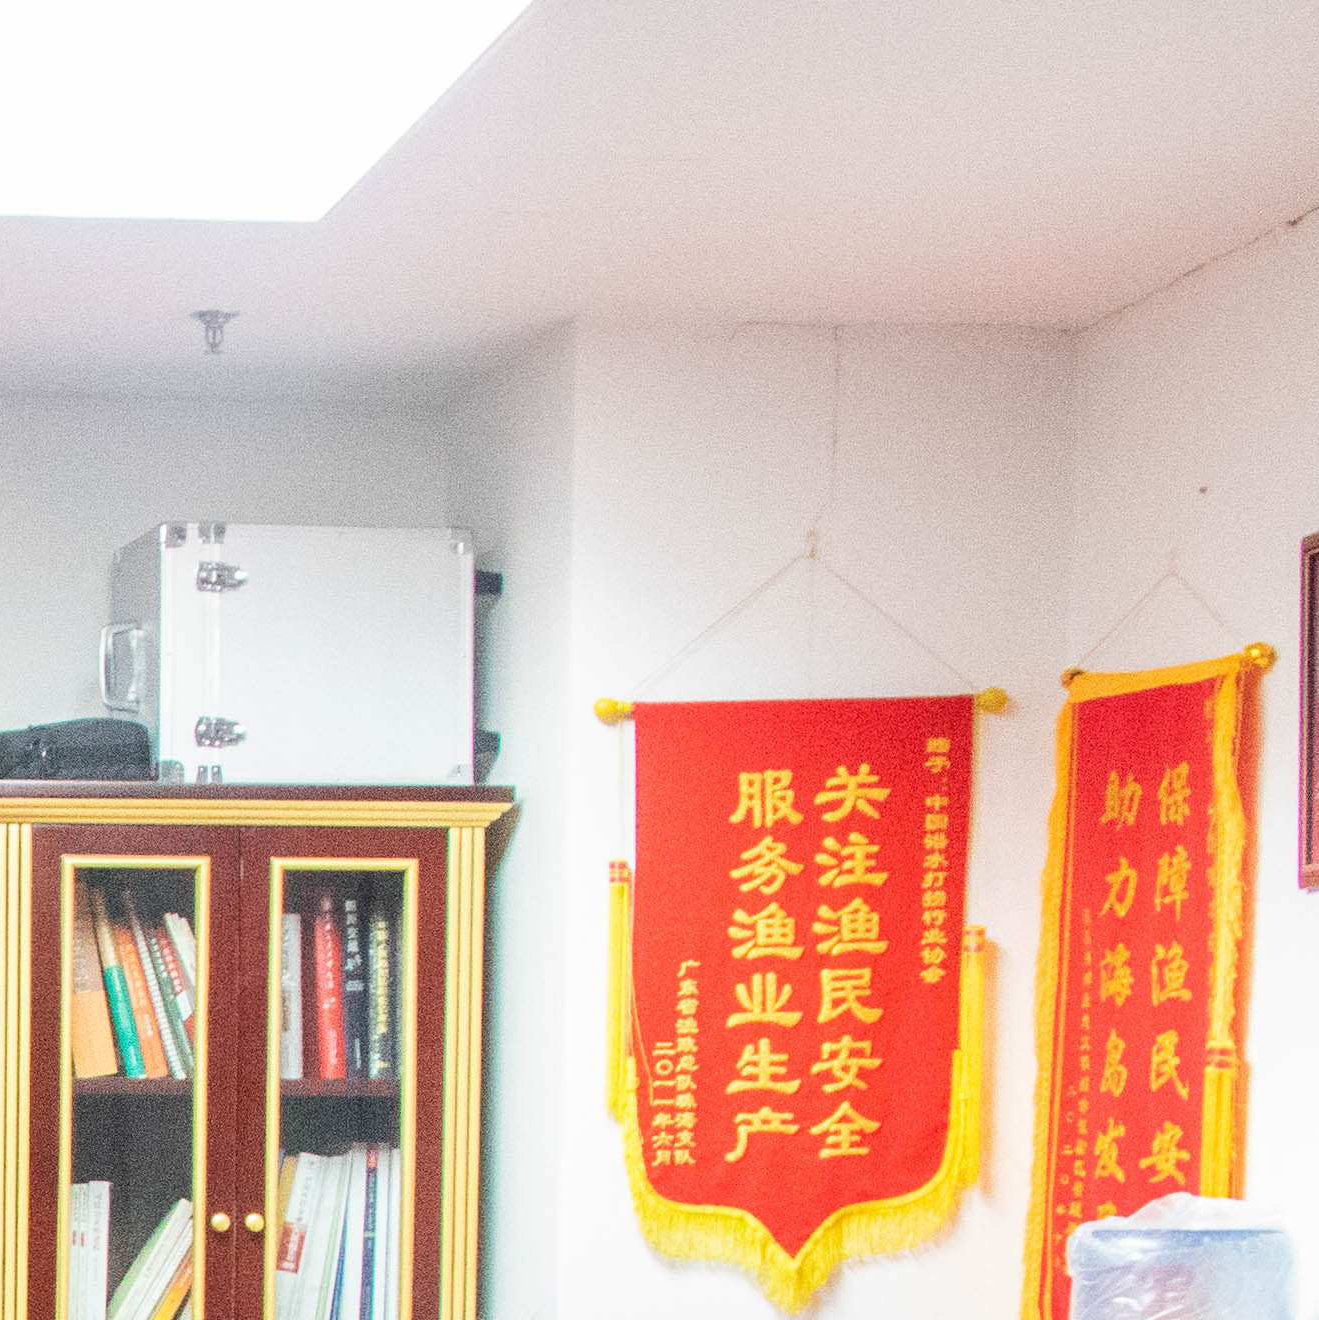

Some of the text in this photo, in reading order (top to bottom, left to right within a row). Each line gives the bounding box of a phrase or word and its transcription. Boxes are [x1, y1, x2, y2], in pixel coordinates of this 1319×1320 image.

[725, 769, 804, 1163] 服务渔业生产
[809, 762, 892, 1160] 关注渔民安全
